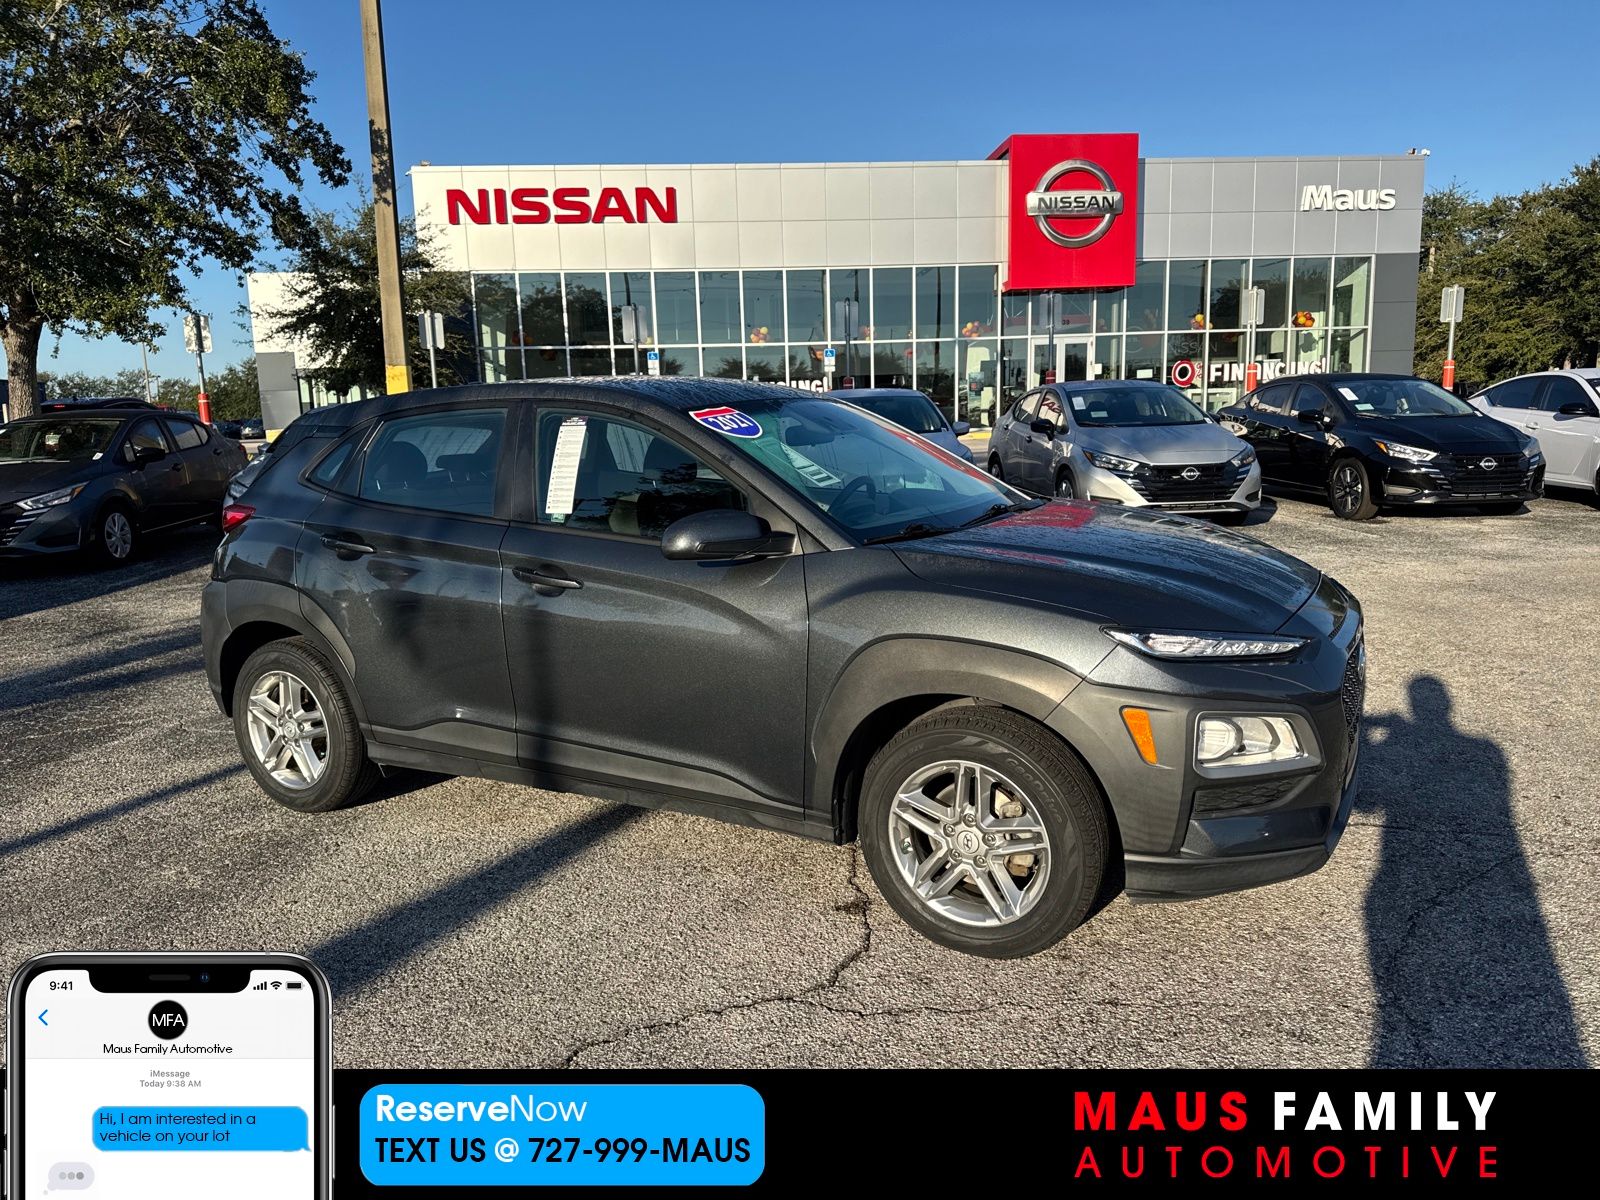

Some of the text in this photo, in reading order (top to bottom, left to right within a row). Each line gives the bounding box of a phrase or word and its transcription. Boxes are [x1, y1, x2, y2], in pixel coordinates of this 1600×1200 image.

[446, 187, 678, 225] NISSAN
[1036, 196, 1117, 211] NISSAN
[1301, 184, 1397, 212] Maus
[707, 413, 754, 430] 2021
